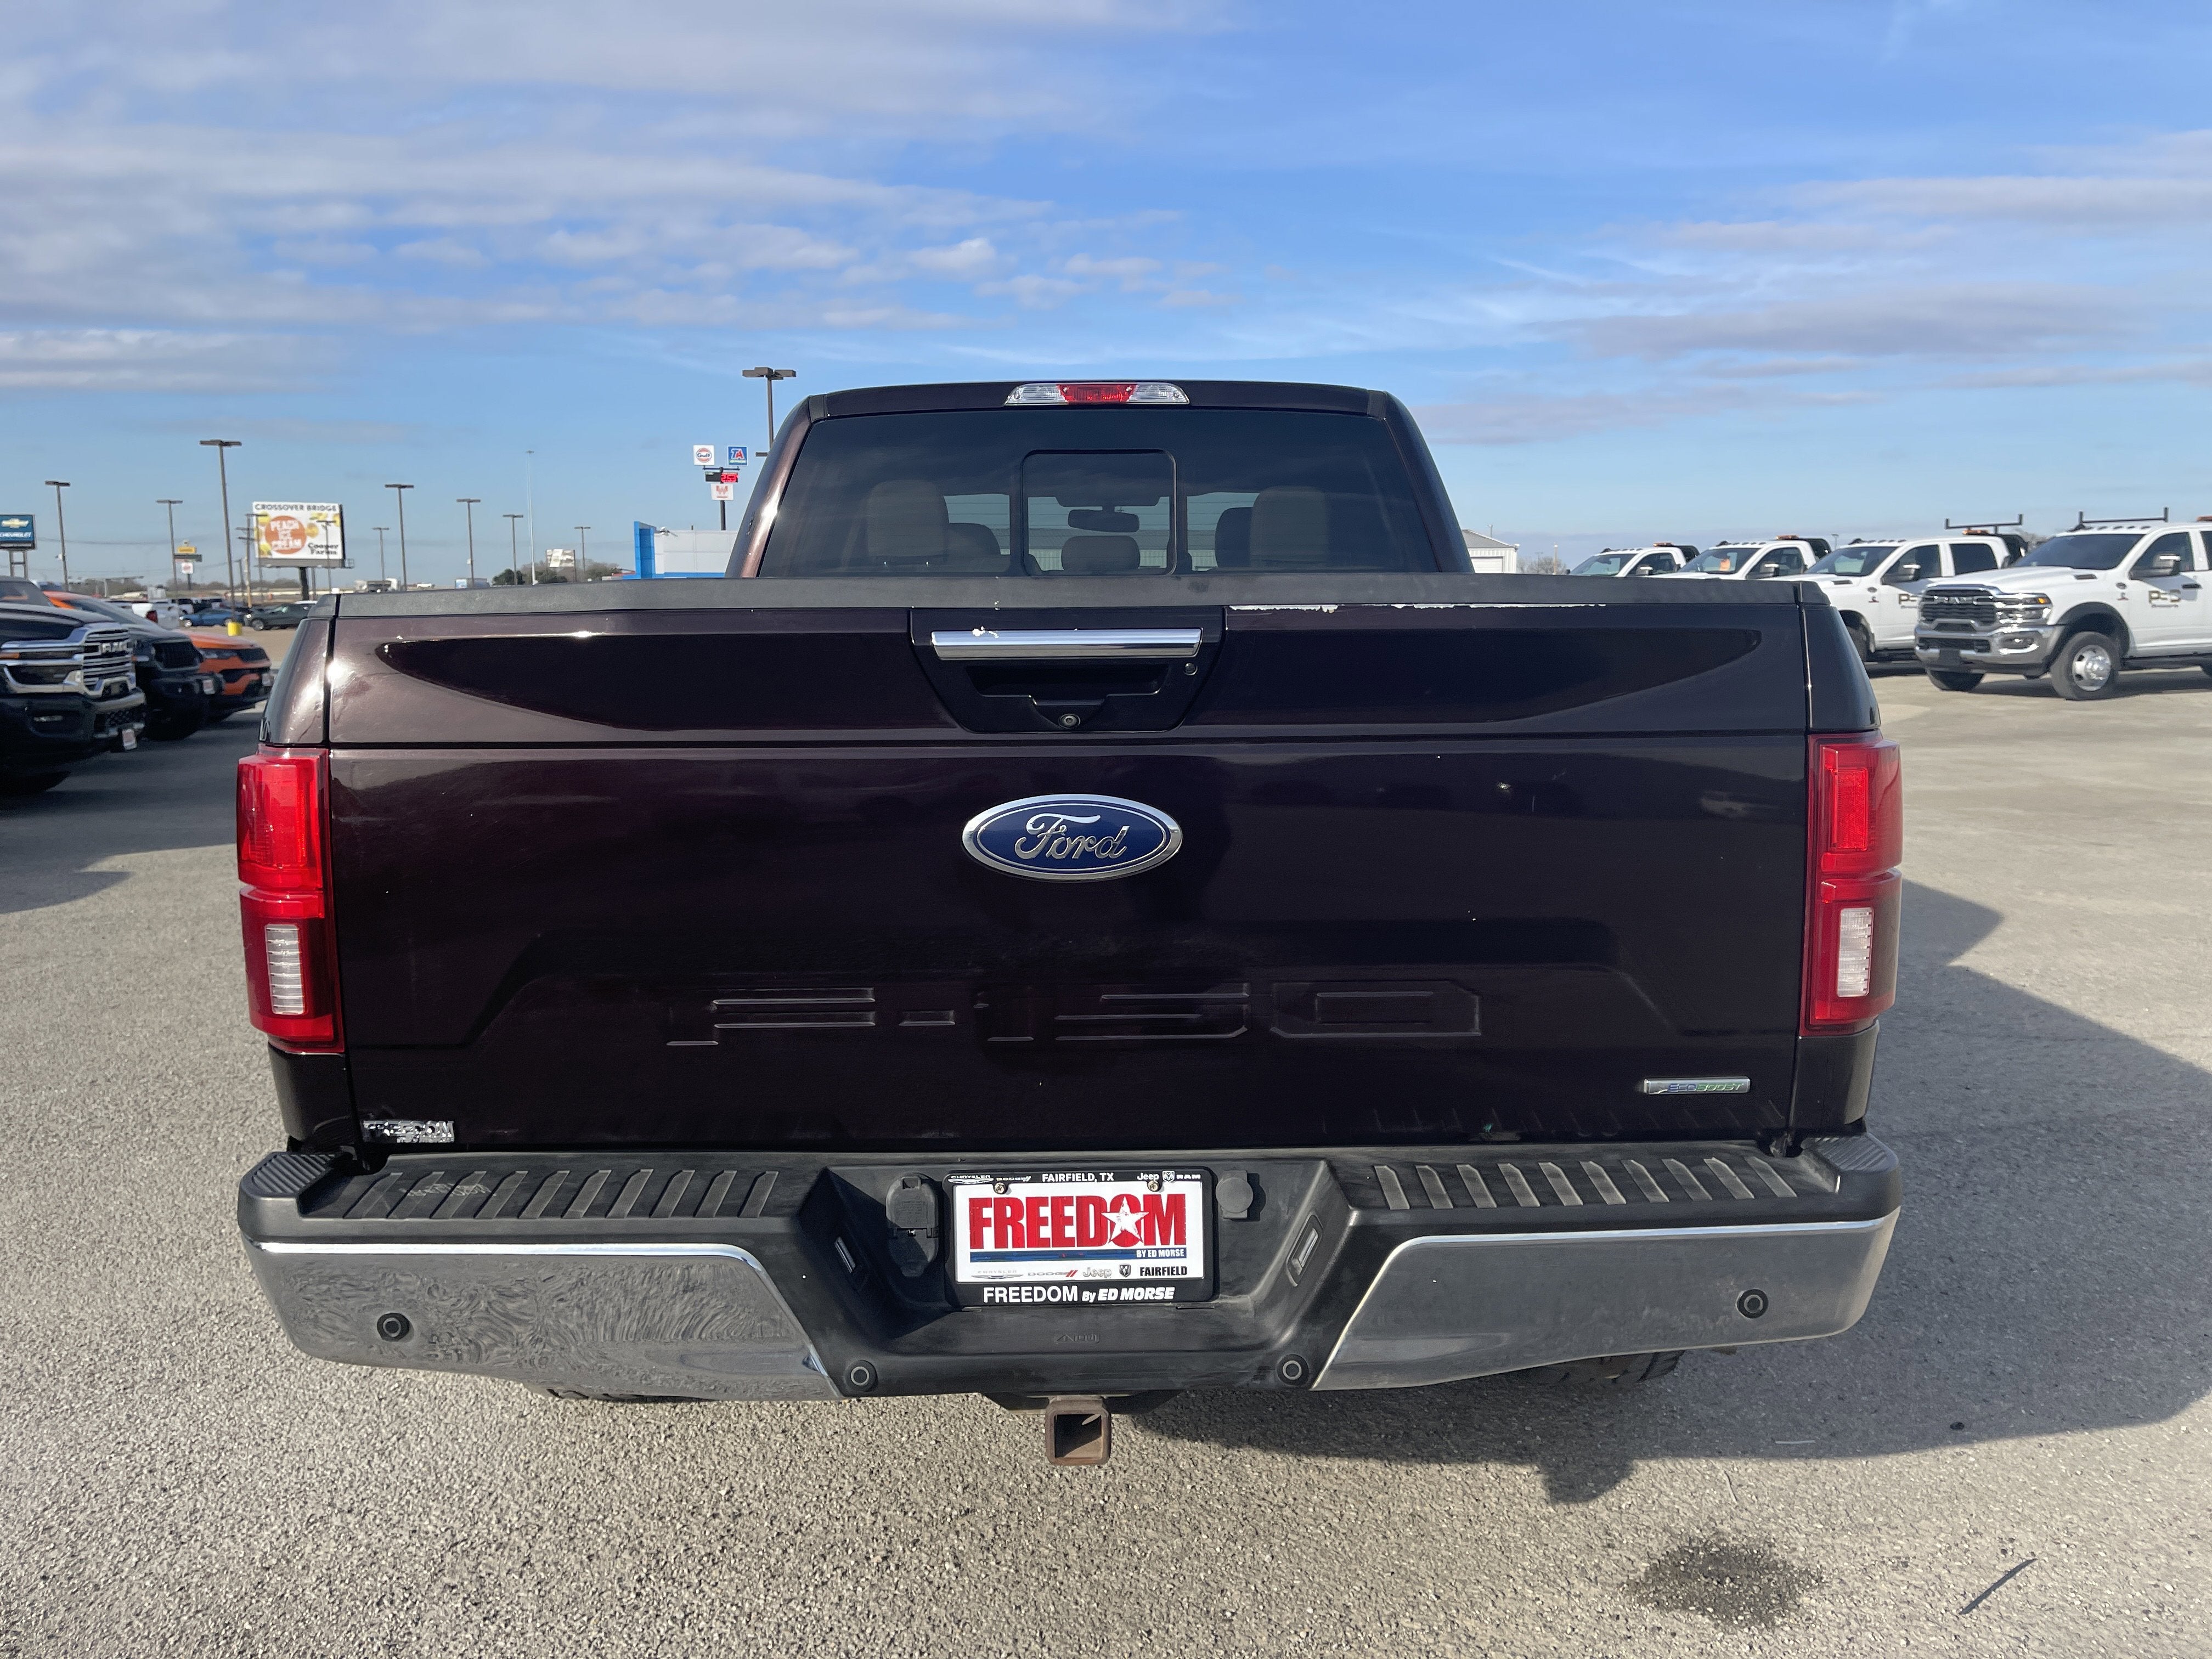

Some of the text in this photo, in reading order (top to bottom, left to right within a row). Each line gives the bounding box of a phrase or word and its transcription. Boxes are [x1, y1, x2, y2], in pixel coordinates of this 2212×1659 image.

[730, 448, 745, 460] TA
[1014, 812, 1130, 859] Ford
[1042, 1172, 1114, 1183] FAIRFIELD, TX
[1137, 1172, 1160, 1181] Jeep
[969, 1194, 1186, 1250] FREEDOM
[1136, 1249, 1184, 1258] BY ED MORSE
[1082, 1267, 1112, 1278] Jeep
[1139, 1266, 1188, 1277] FAIRFIELD
[983, 1285, 1175, 1303] FREEDOM By ED MORSE
